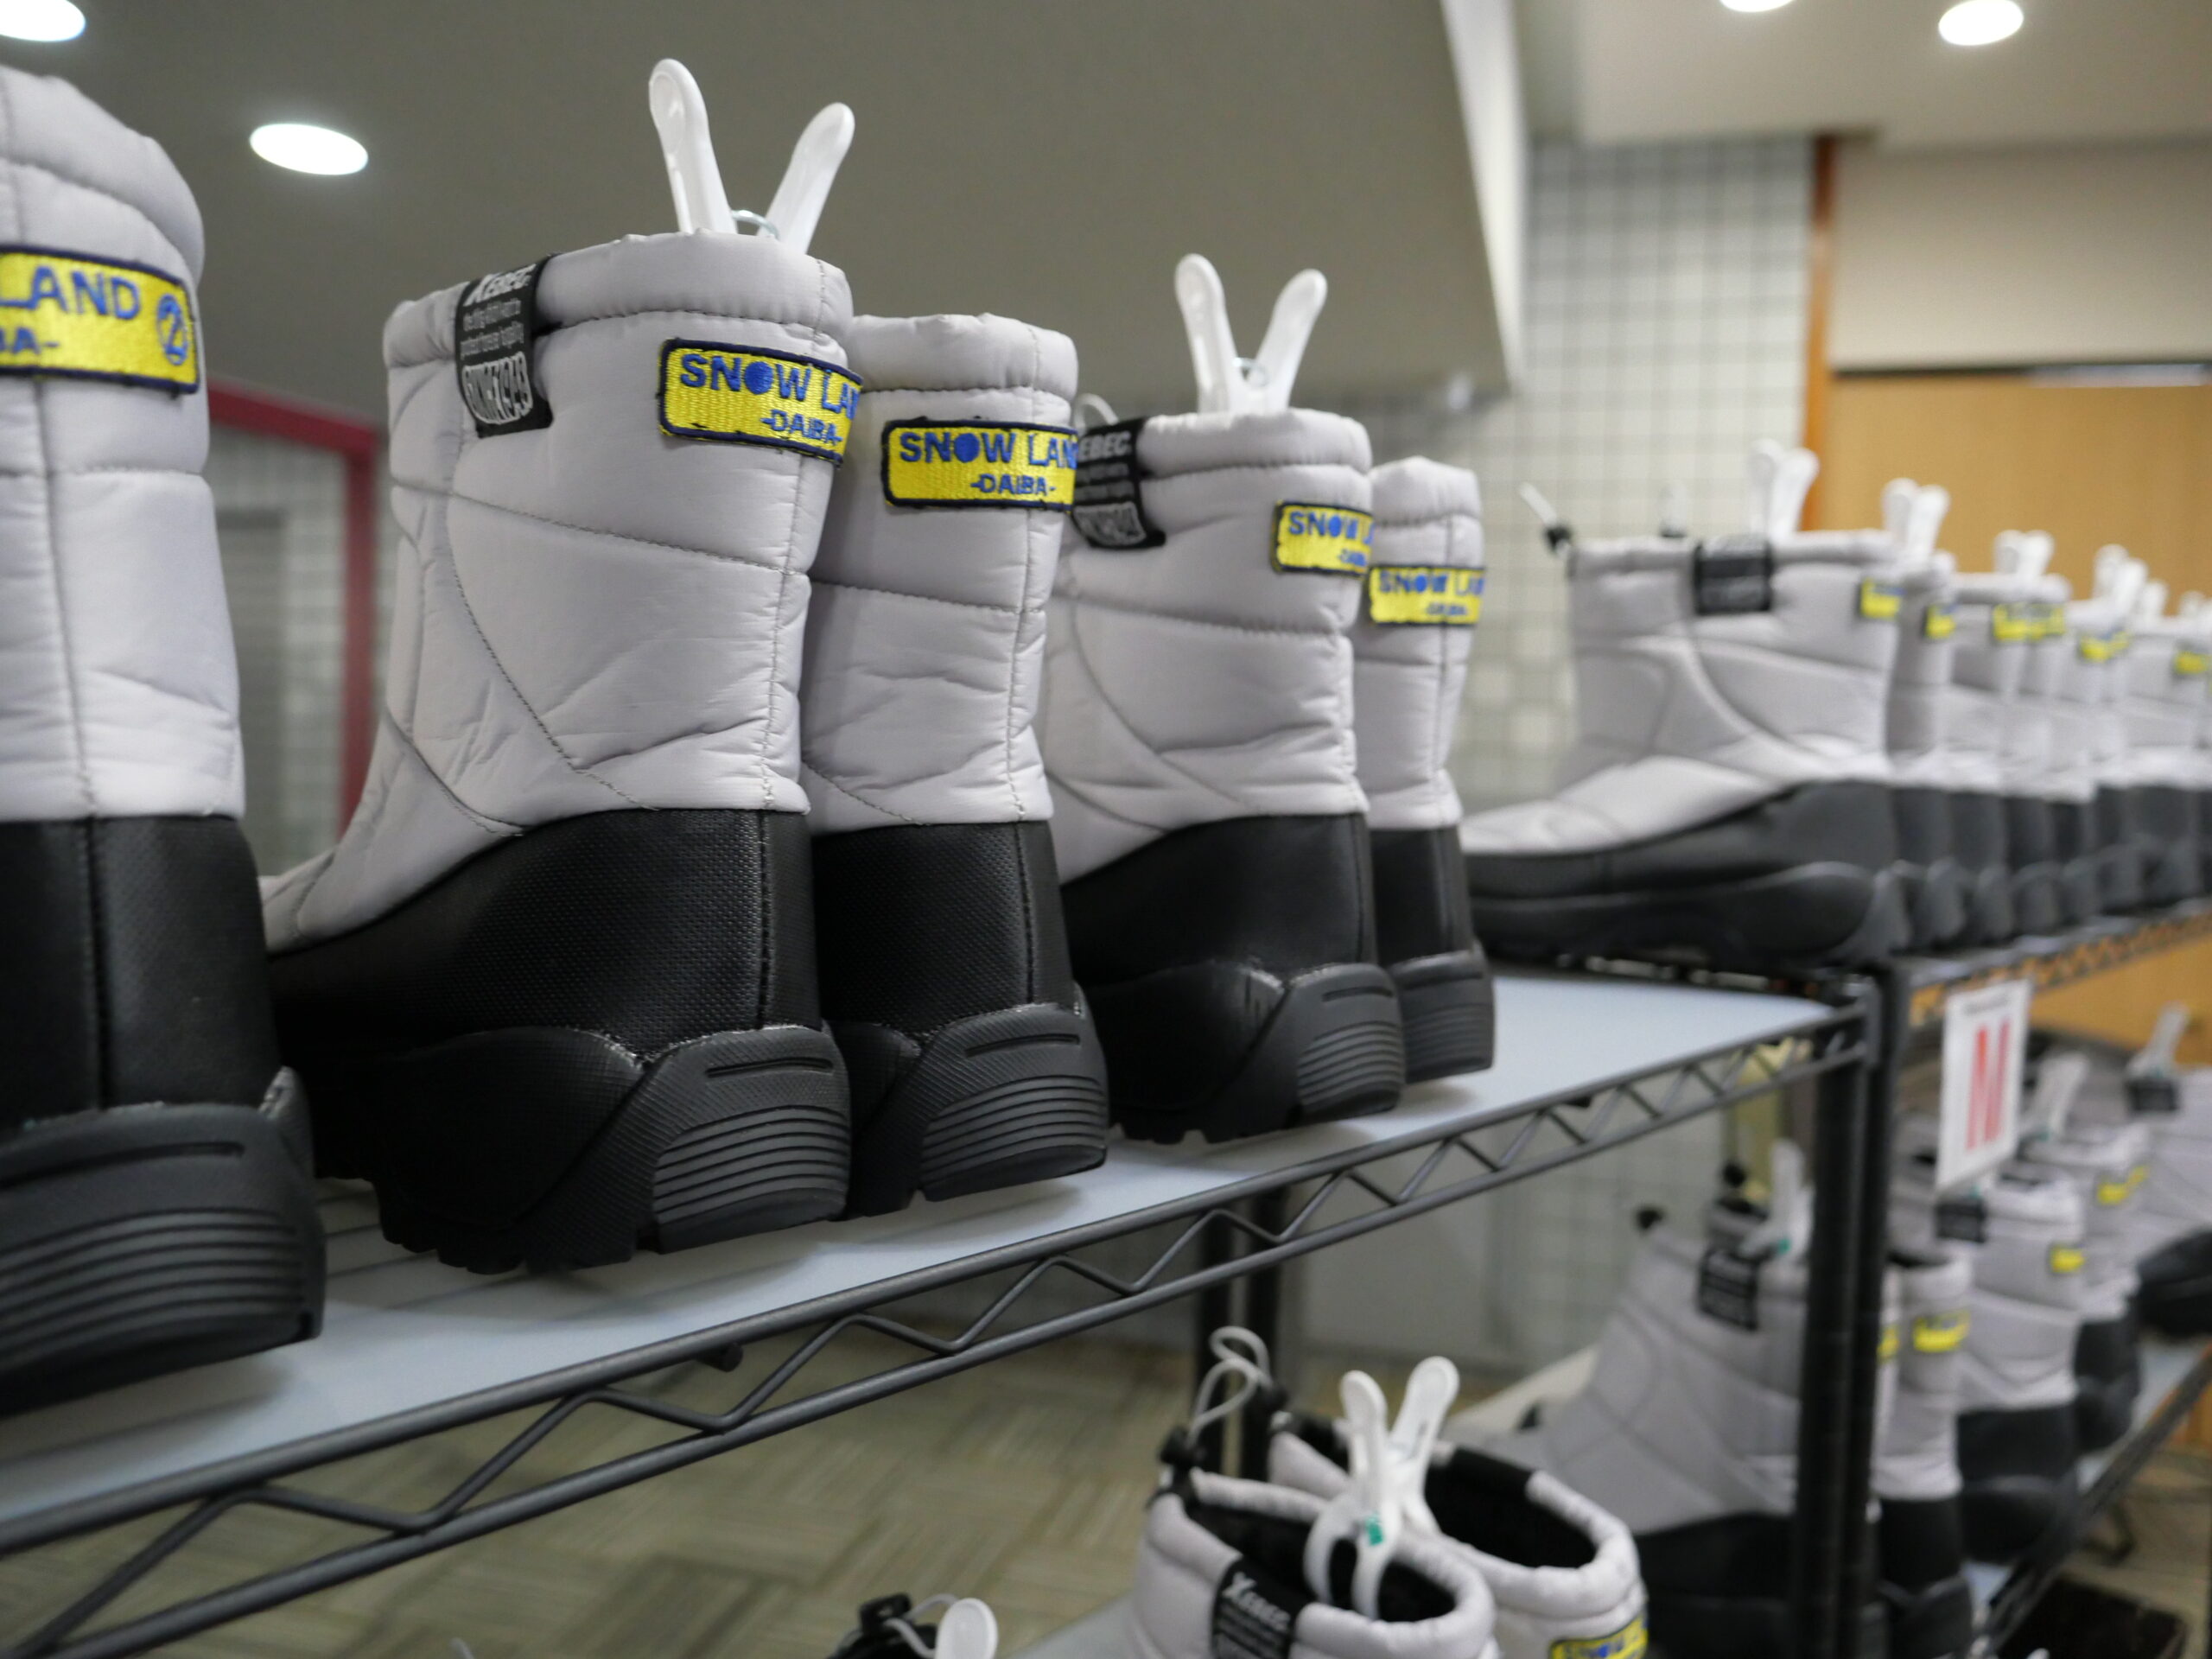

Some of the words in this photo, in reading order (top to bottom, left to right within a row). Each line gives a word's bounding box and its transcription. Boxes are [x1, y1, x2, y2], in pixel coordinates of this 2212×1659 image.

[680, 353, 811, 401] SNOW
[899, 431, 1016, 464] SNOW
[1288, 511, 1358, 540] SNOW
